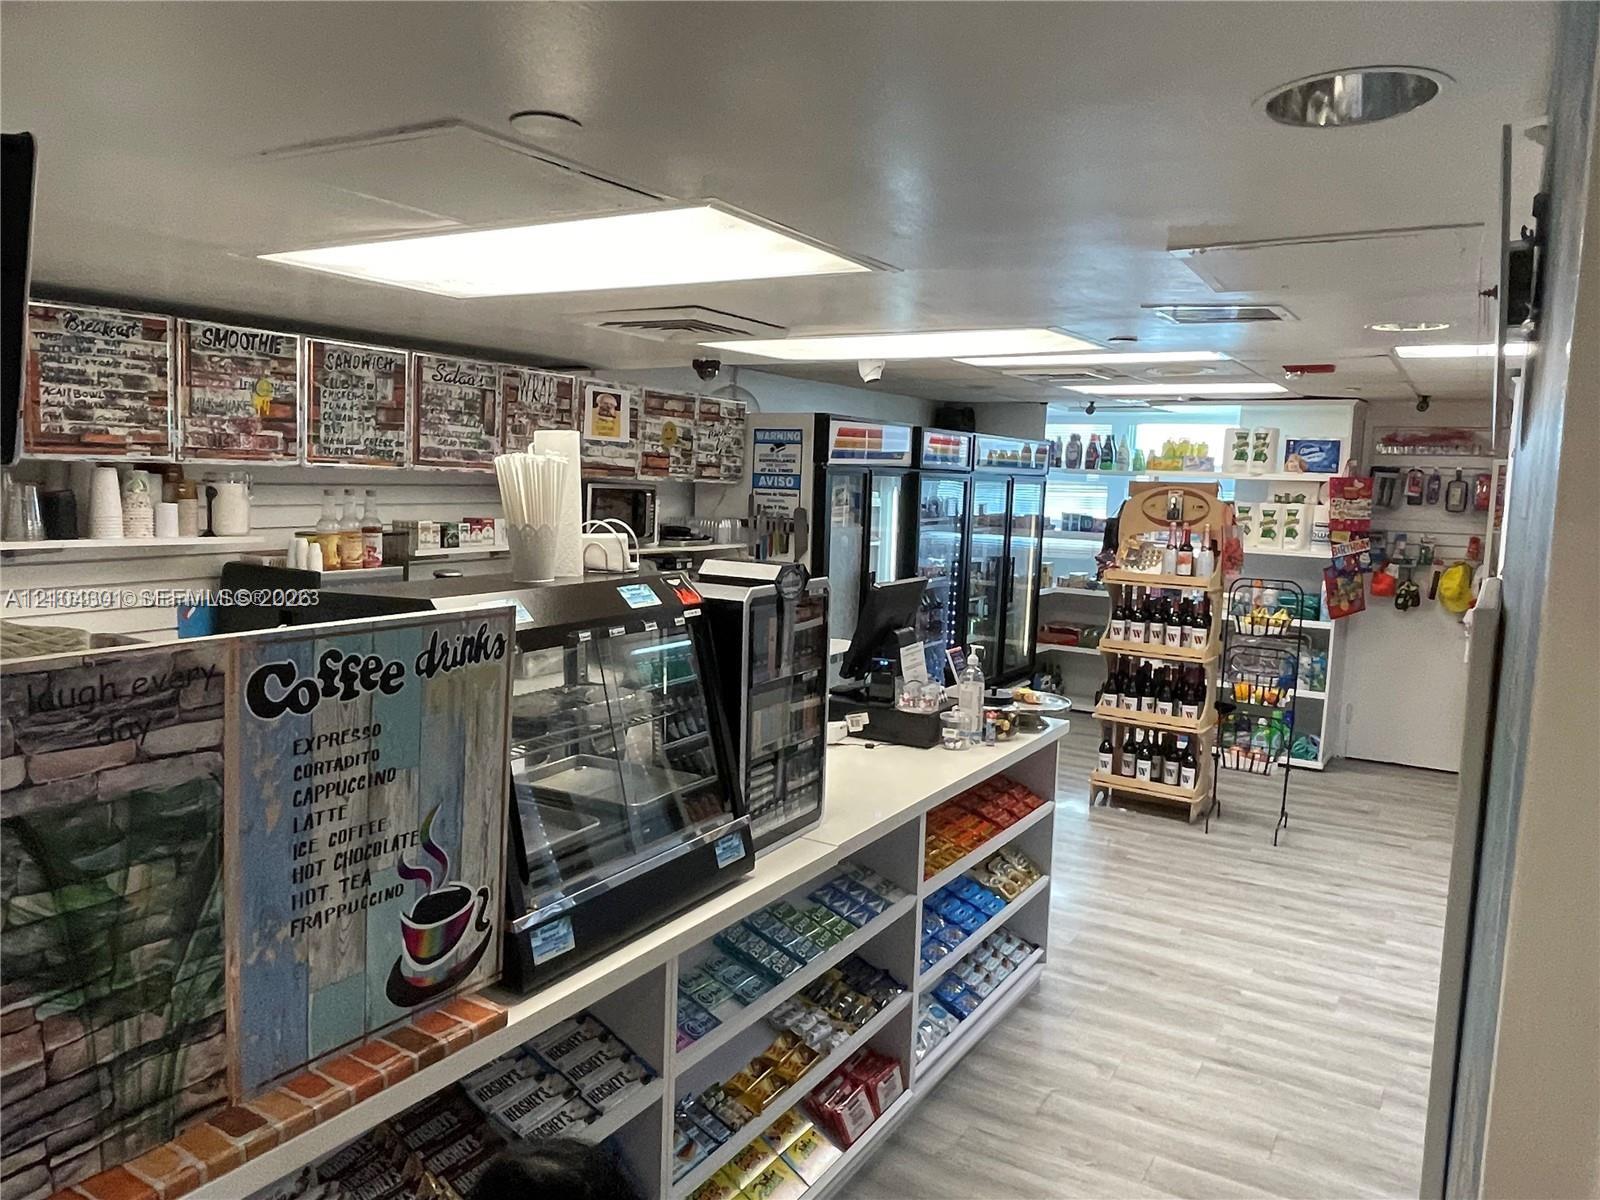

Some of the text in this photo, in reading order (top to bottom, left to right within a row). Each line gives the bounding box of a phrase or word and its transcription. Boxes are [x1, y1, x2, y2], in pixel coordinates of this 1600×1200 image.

[202, 328, 284, 354] SMOOTHIE
[325, 352, 396, 371] SANDWICH
[72, 389, 105, 399] BOWL
[756, 431, 801, 441] WARNING
[758, 476, 795, 488] AVISO
[1331, 538, 1371, 558] BIRTHDAY
[131, 663, 217, 698] every
[245, 622, 507, 720] Coffee drinks
[97, 717, 151, 746] day
[292, 723, 382, 756] EXPRESSO
[293, 749, 381, 782] CORTADITO
[292, 767, 397, 808] CAPPUCCINO
[292, 804, 349, 834] LATTE
[292, 817, 388, 861] ICE COFFEE
[292, 830, 420, 885] HOT CHOCOLATE
[291, 870, 373, 911] HOT TEA
[289, 883, 405, 938] FRAPPUCCINO
[546, 1030, 589, 1061] HERSHEY'S
[567, 1050, 611, 1082] HERSHEY'S
[477, 1068, 523, 1102] HERSHEY'S
[587, 1071, 630, 1104] HERSHEY'S
[503, 1086, 550, 1122] HERSHEY'S
[404, 1111, 460, 1149] HERSHEY'S
[425, 1134, 481, 1173] HERSHEY'S
